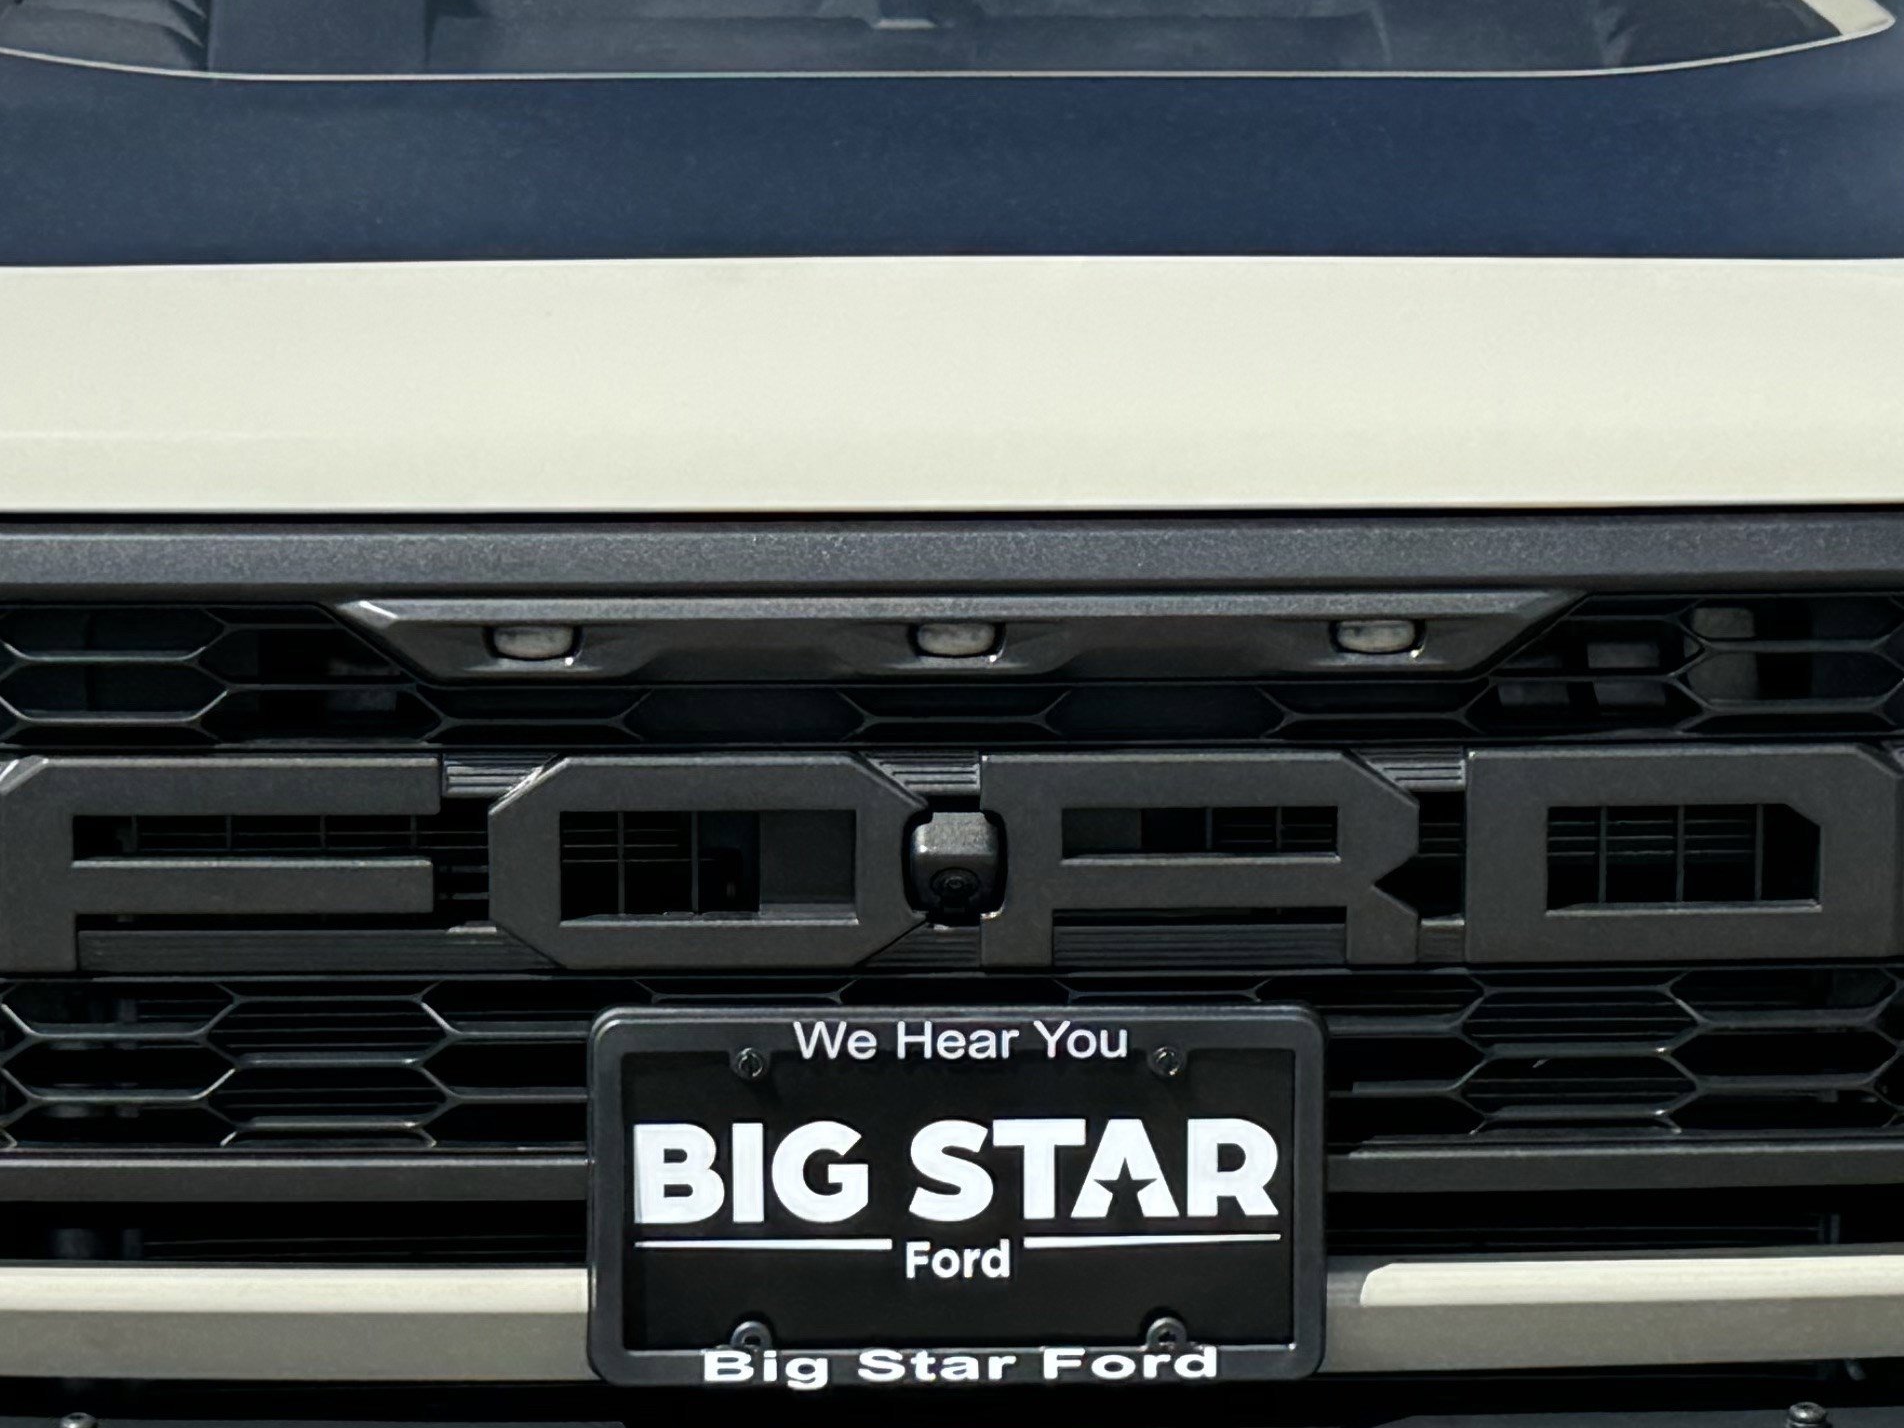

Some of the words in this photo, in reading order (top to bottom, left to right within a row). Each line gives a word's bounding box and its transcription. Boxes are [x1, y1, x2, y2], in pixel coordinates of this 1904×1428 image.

[792, 1020, 878, 1060] We
[897, 1020, 1020, 1060] Hear
[1032, 1019, 1129, 1059] You
[632, 1120, 869, 1224] BIG
[908, 1118, 1280, 1222] STAR
[905, 1238, 1011, 1279] Ford
[702, 1349, 828, 1391] Big
[857, 1348, 1017, 1381] Star
[1042, 1346, 1218, 1380] Ford
